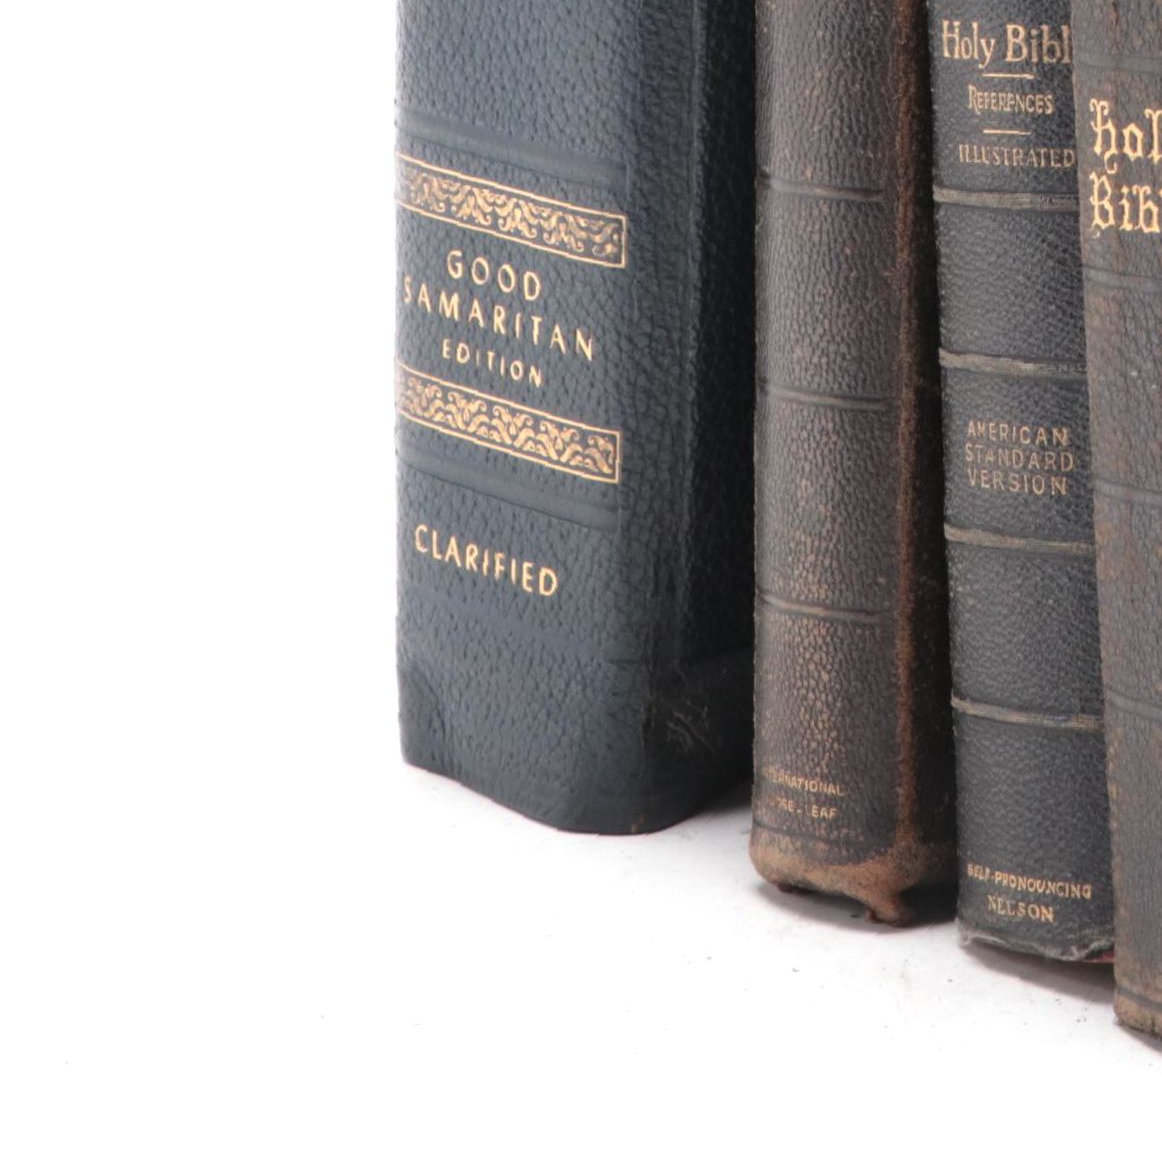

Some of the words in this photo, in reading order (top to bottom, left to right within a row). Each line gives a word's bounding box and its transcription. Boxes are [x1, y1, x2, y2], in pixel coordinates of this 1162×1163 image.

[942, 20, 995, 69] Holy
[1005, 22, 1072, 64] Bibl
[958, 144, 1076, 168] ILLUSTRATED
[446, 249, 543, 301] GOOD
[403, 275, 594, 363] SAMARITAN
[442, 338, 543, 388] EDITION
[966, 419, 1071, 447] AMERICAN
[965, 442, 1074, 472] STANDARD
[968, 468, 1068, 496] VERSION
[414, 524, 559, 597] CLARIFIED
[987, 894, 1056, 923] NELSON
